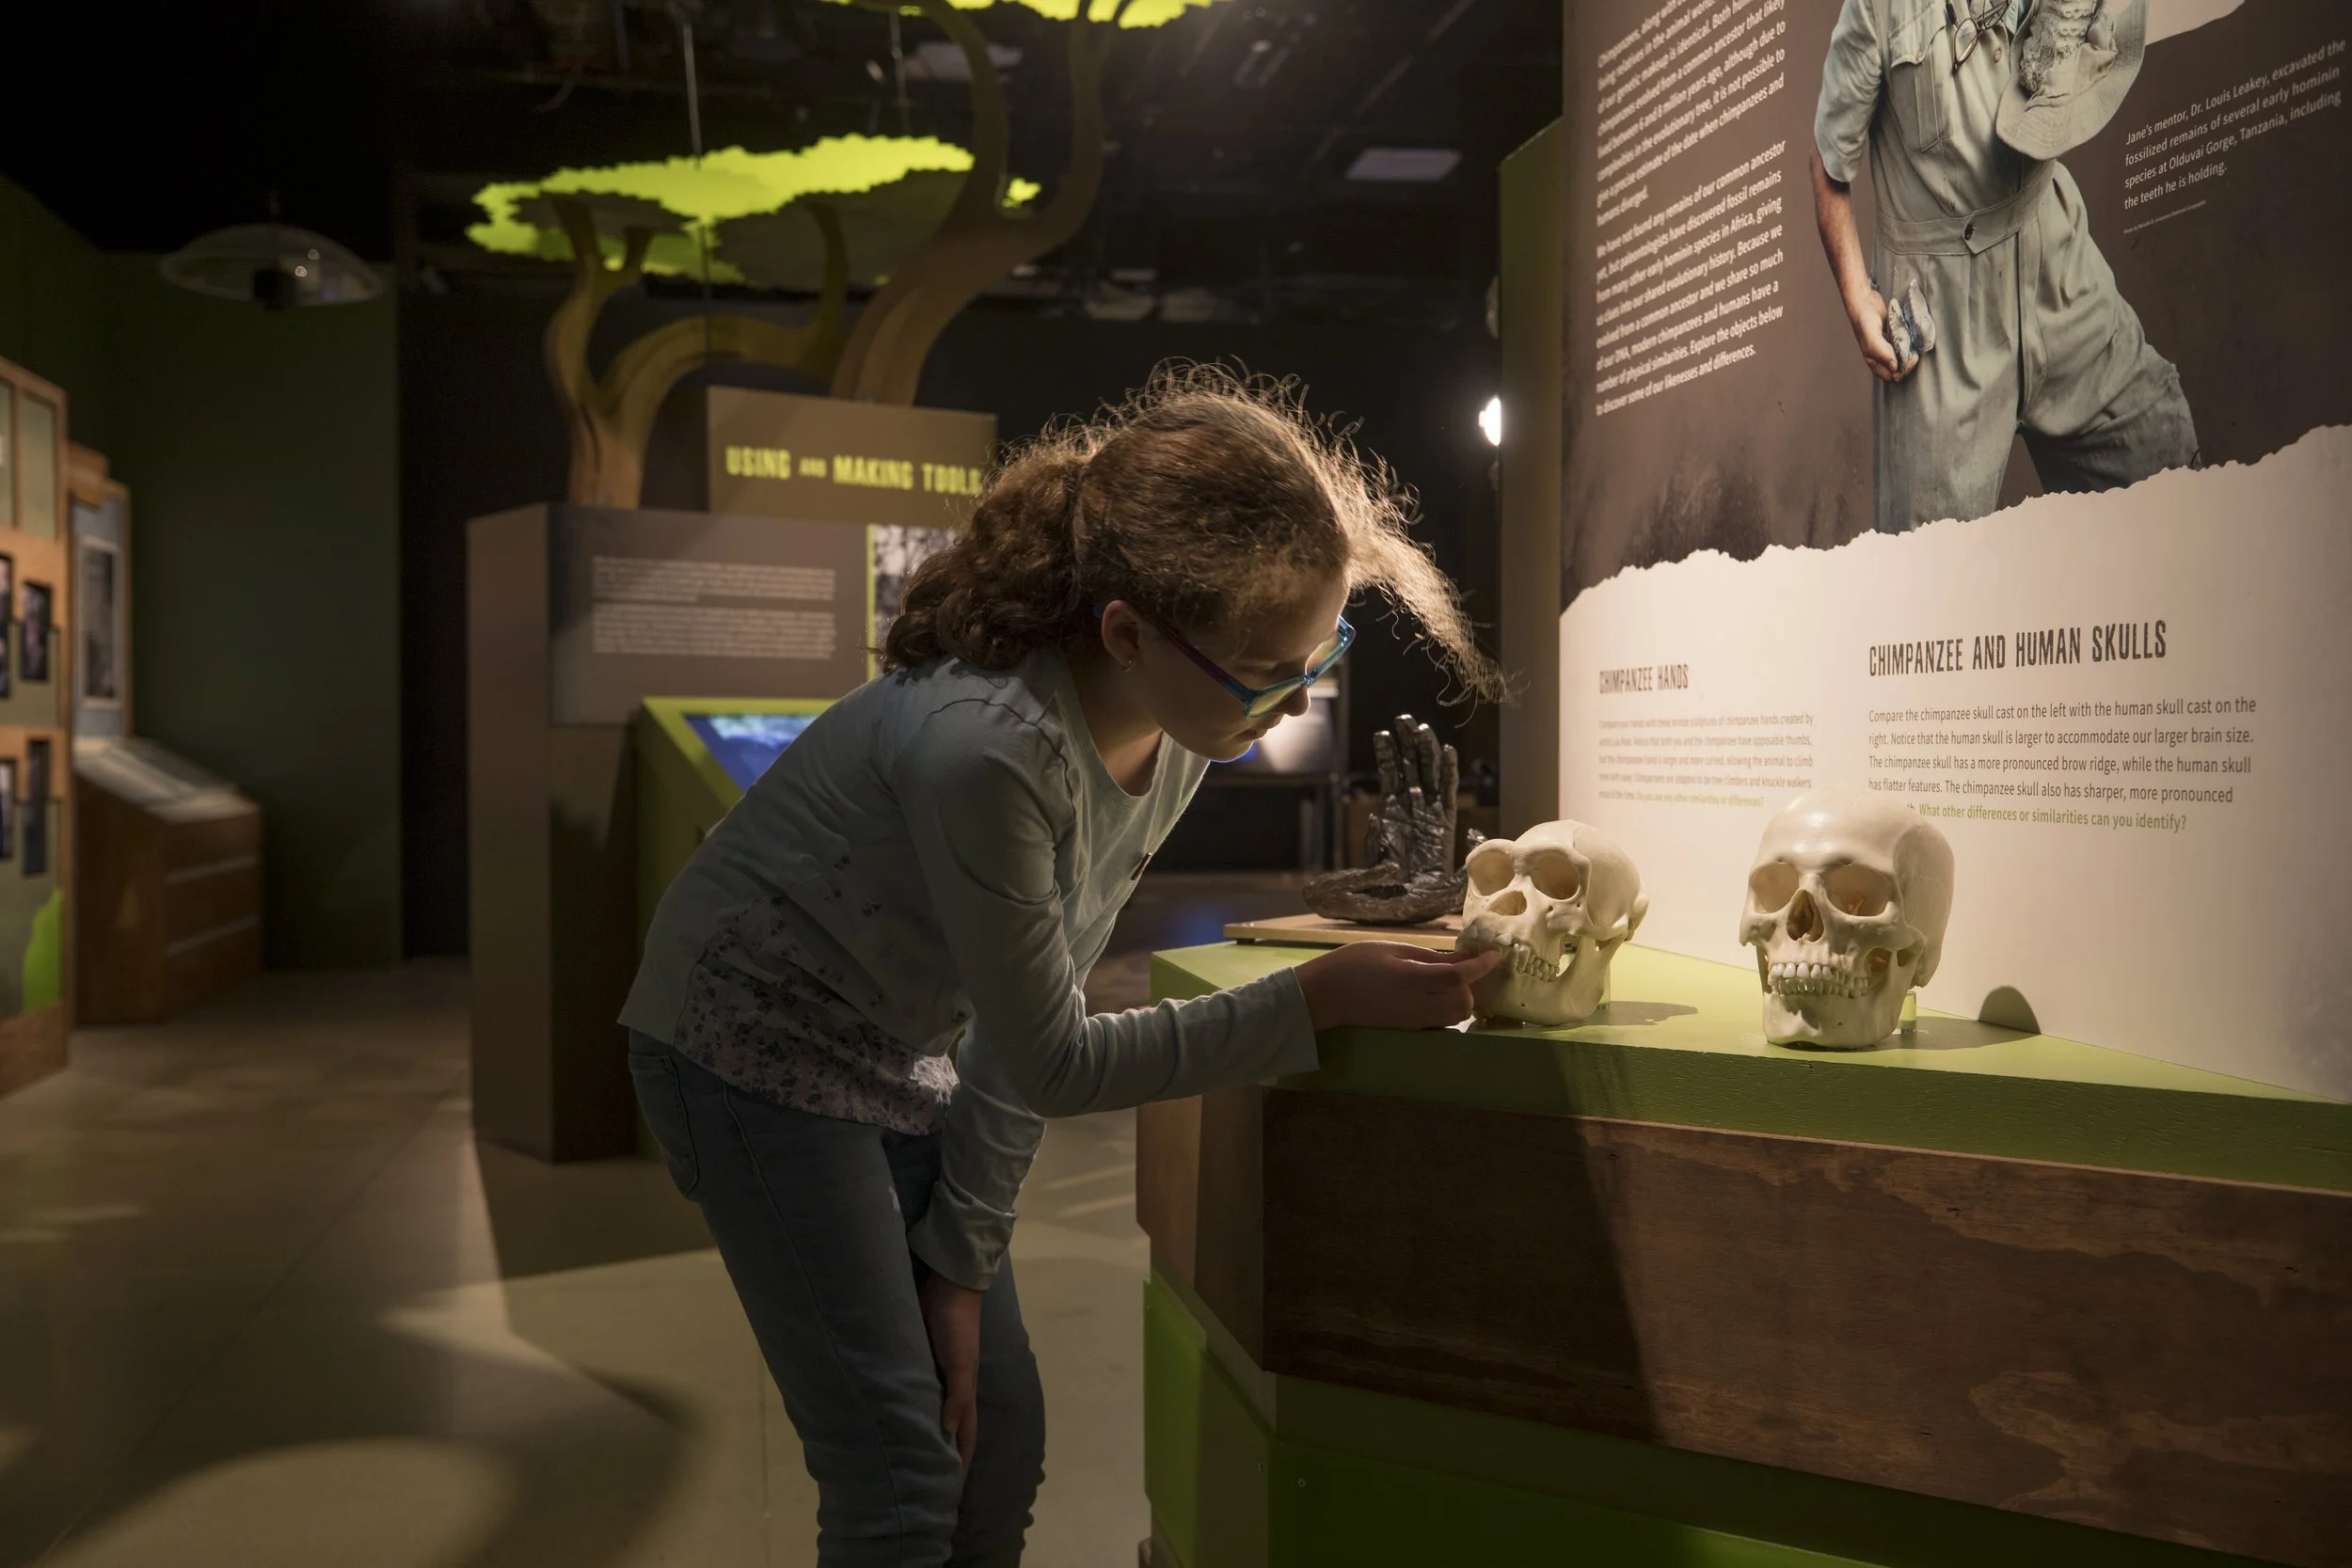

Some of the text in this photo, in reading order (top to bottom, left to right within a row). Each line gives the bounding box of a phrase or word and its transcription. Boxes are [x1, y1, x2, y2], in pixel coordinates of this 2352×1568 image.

[1758, 27, 1776, 48] due
[1775, 20, 1787, 36] to
[1740, 53, 1775, 90] possible
[1774, 48, 1786, 64] to
[1718, 86, 1768, 127] chimpanzees
[1767, 71, 1785, 96] and
[2125, 39, 2347, 146] Jane's mentor, Dr. Louis Leakey, excavated the
[2124, 66, 2340, 166] fossilized remains of several early hominin
[2123, 89, 2342, 190] species at Olduvai Gorge, Tanzania, including
[1714, 161, 1750, 190] common
[1750, 139, 1787, 170] ancestor
[1725, 184, 1748, 210] fossil
[1748, 169, 1782, 198] remains
[2123, 161, 2228, 210] the teeth he is holding.
[1729, 212, 1756, 234] Africa,
[1756, 196, 1783, 225] giving
[1736, 230, 1770, 257] Because
[1769, 224, 1783, 240] we
[1748, 262, 1759, 277] so
[1759, 247, 1784, 272] much
[1751, 283, 1772, 302] have
[1772, 279, 1779, 293] a
[1728, 315, 1758, 339] objects
[1757, 305, 1784, 326] below
[1697, 356, 1713, 376] and
[1712, 343, 1756, 371] differences.
[725, 445, 790, 480] USING
[833, 454, 914, 490] MAKING
[921, 462, 981, 496] TOOLS
[1868, 619, 2167, 677] CHIMPANZEE AND HUMAN SKULLS
[1598, 662, 1689, 695] CHIMPANZEE HANDS
[1779, 713, 1804, 725] created
[1804, 712, 1814, 727] by
[1867, 695, 2257, 724] Compare the chimpanzee skull cast on the left with the human skull cast on the
[1752, 734, 1785, 747] opposable
[1785, 734, 1813, 747] thumbs,
[1867, 726, 2254, 750] right. Notice that the human skull is larger to accommodate our larger brain size.
[1786, 755, 1794, 768] to
[1793, 754, 1814, 768] climb
[1867, 754, 2251, 776] The chimpanzee skull has a more pronounced brow ridge, while the human skull
[1761, 775, 1786, 788] knuckle
[1786, 775, 1813, 789] walkers
[1867, 777, 2233, 805] has flatter features. The chimpanzee skull also has sharper, more pronounced
[1918, 802, 1940, 817] What
[1941, 804, 1965, 818] other
[1966, 804, 2017, 821] differences
[2018, 810, 2030, 822] or
[2031, 807, 2089, 825] similarities
[2090, 814, 2110, 826] can
[2112, 815, 2133, 831] you
[2135, 812, 2187, 834] identify?
